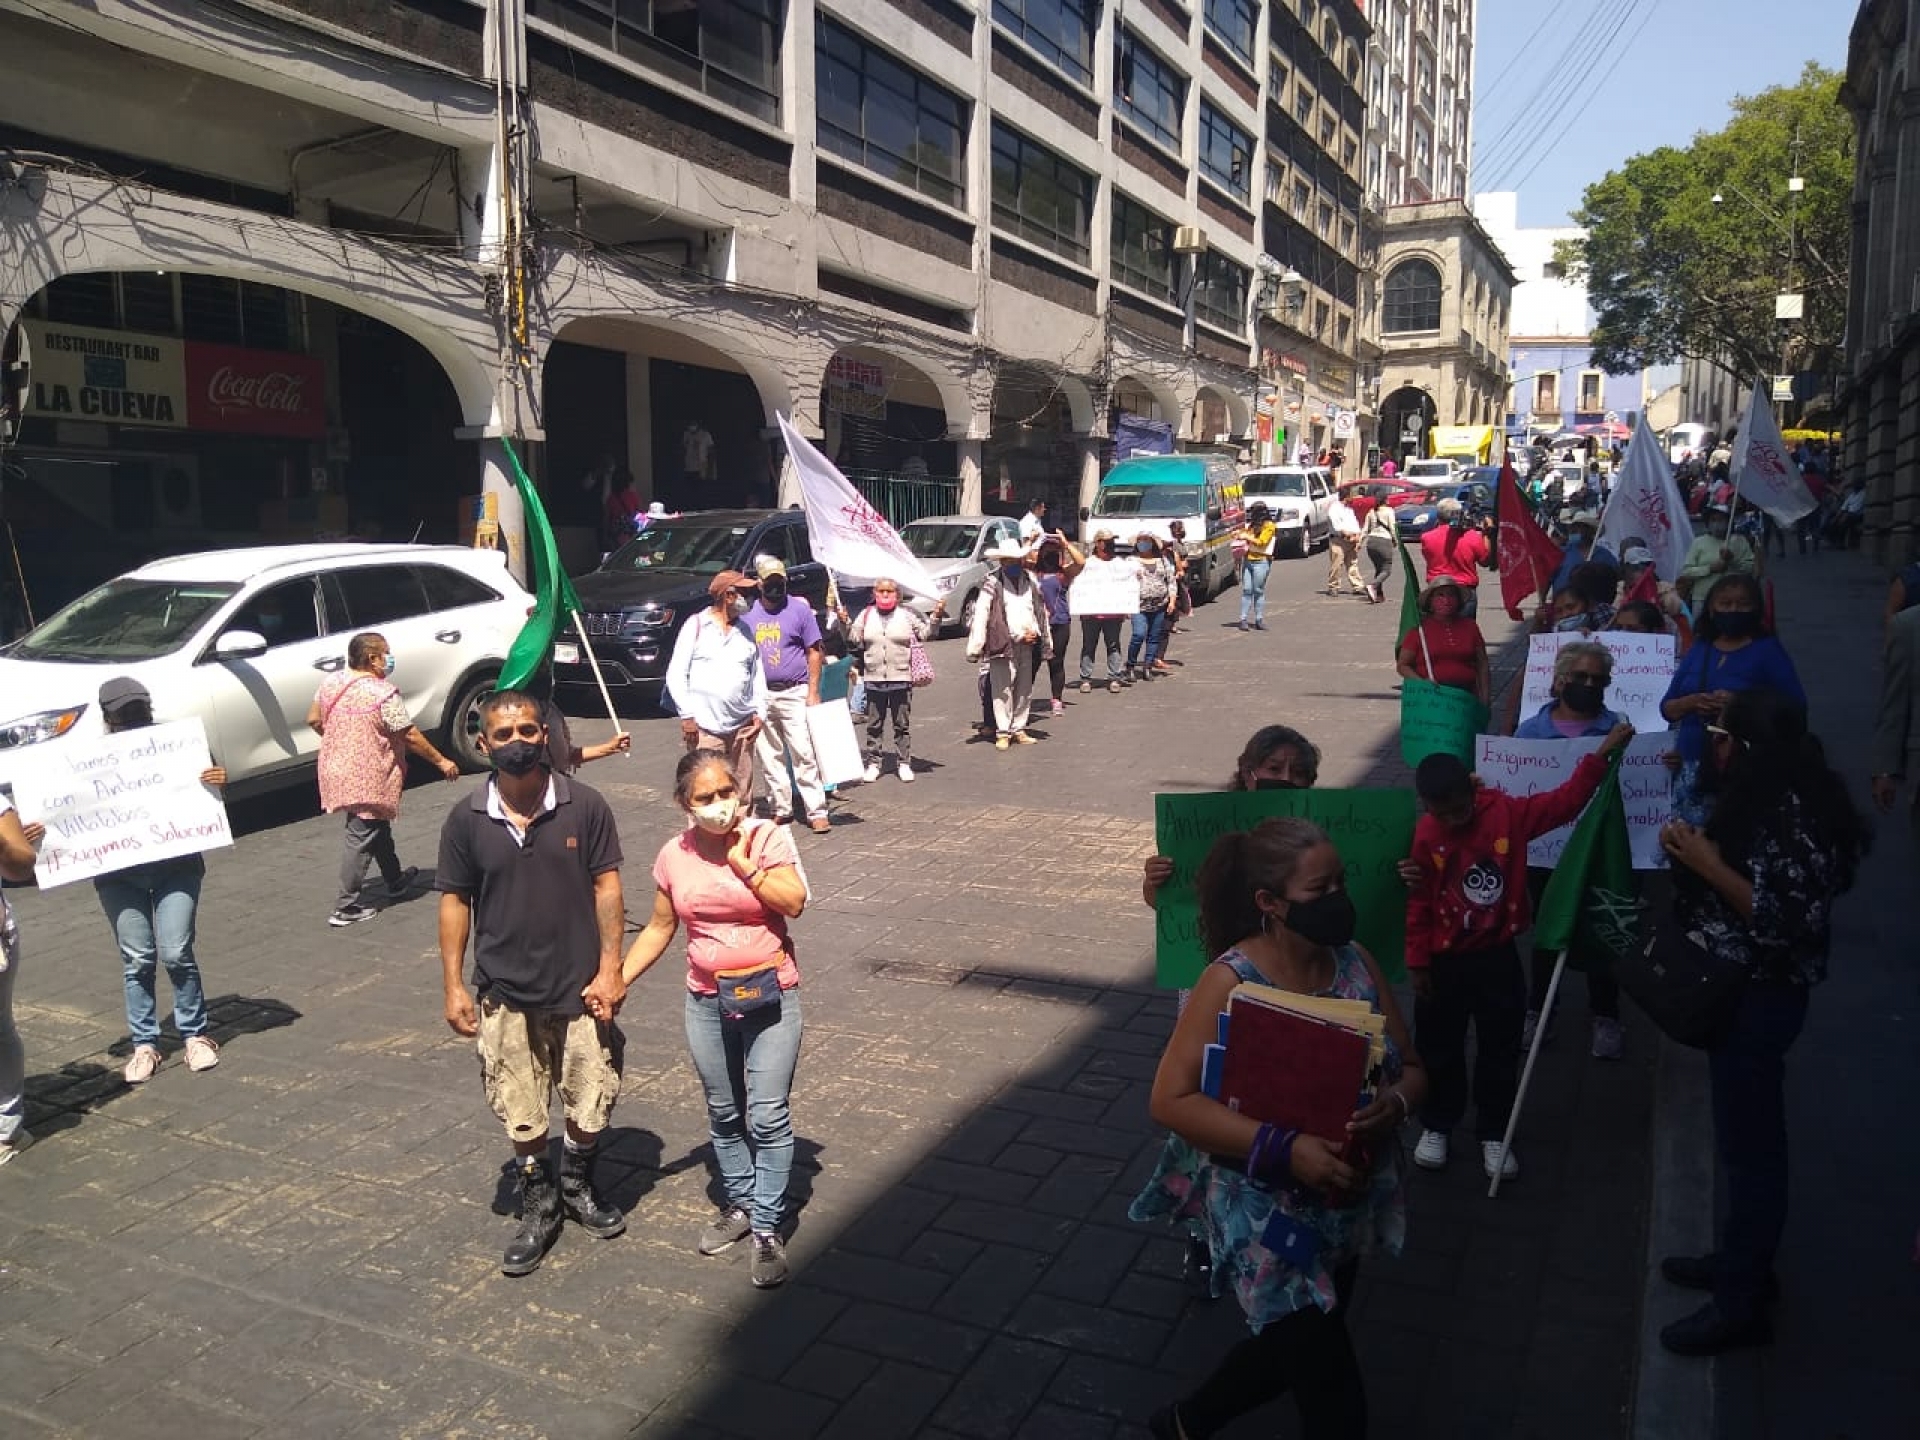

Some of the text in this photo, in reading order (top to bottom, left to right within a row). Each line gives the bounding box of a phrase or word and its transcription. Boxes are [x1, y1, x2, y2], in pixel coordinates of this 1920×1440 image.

[45, 332, 160, 362] RESTAURANT BAR
[35, 383, 175, 421] LA CUEVA
[1482, 740, 1561, 775] Exigimos
[43, 772, 164, 809] con Antonio
